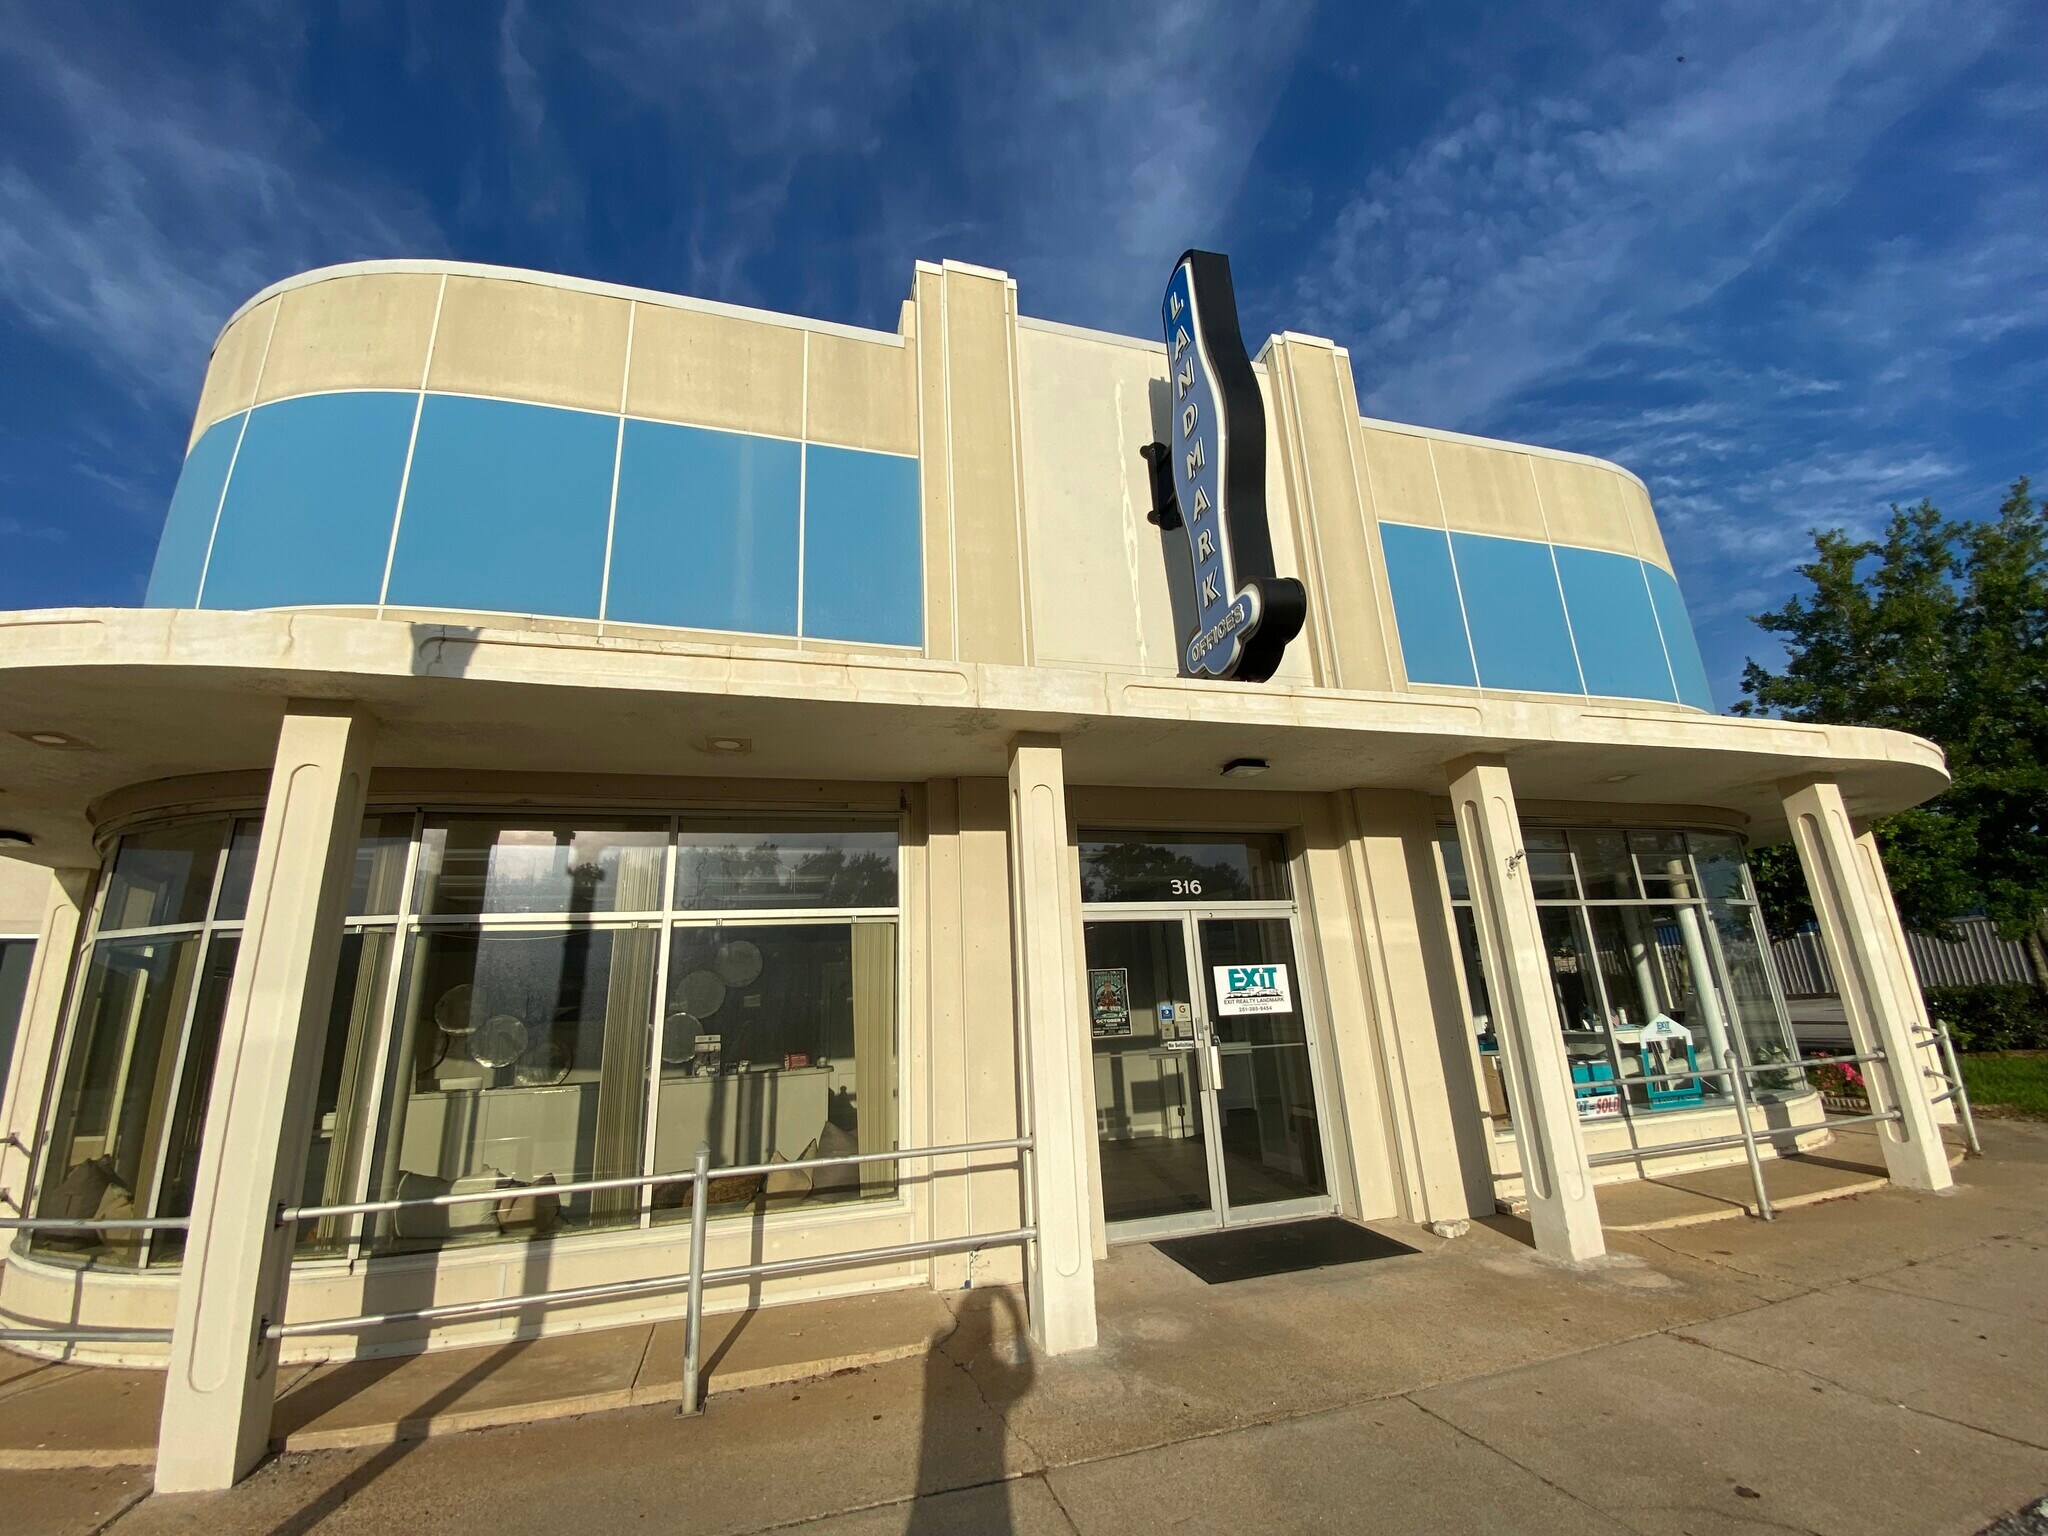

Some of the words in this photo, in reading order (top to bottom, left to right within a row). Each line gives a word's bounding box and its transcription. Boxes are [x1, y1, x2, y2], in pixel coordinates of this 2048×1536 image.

[1170, 291, 1221, 609] LANDMARK
[1191, 603, 1244, 661] OFFICES
[1170, 879, 1202, 895] 316
[1179, 1005, 1186, 1013] G
[1596, 1096, 1620, 1114] SOLD
